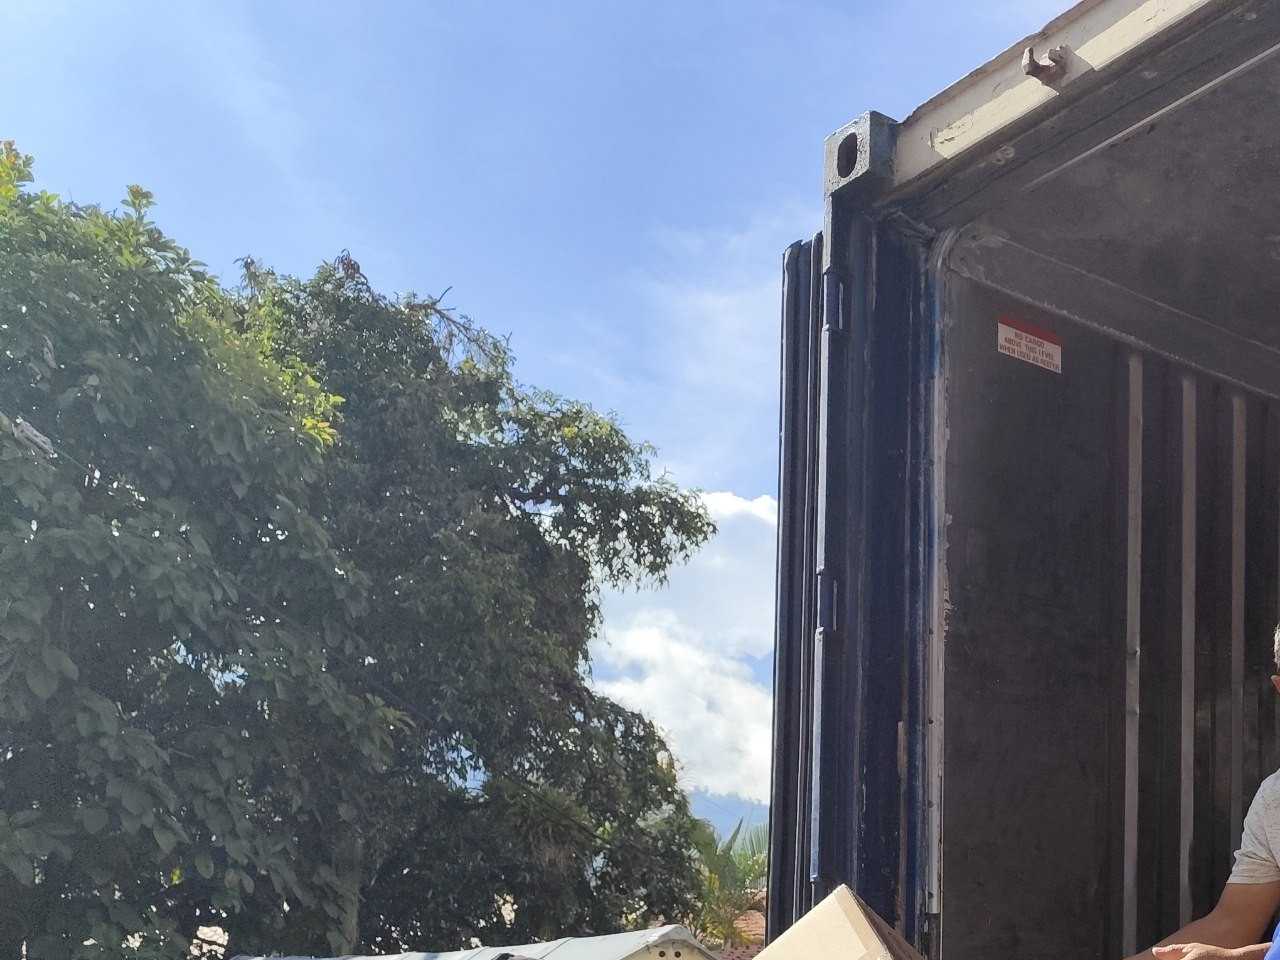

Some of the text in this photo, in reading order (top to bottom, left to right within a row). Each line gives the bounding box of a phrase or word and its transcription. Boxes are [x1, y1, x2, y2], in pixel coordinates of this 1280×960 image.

[1004, 337, 1021, 348] ABOVE
[1025, 344, 1036, 354] THIS
[1015, 332, 1044, 348] NO CARGO
